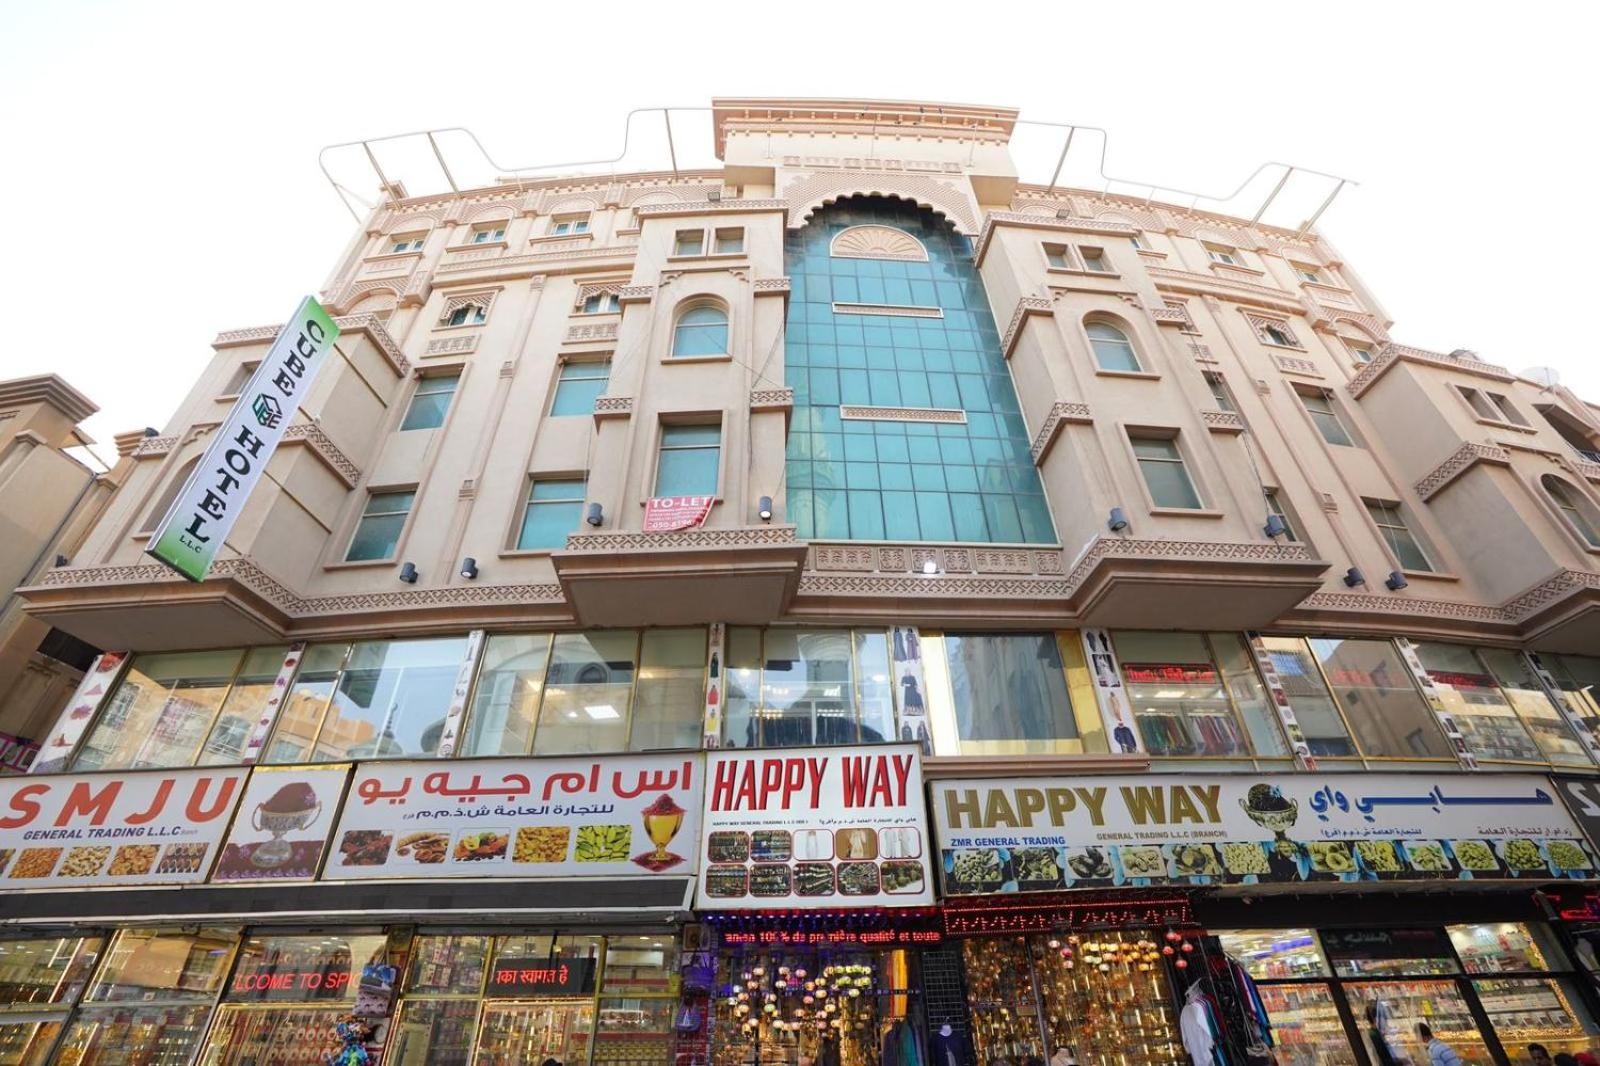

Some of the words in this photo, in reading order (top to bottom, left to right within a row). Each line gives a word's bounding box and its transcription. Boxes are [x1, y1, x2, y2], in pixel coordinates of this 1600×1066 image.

[185, 424, 265, 543] HOTEL
[358, 773, 413, 806] يو
[543, 764, 600, 800] ام
[612, 761, 692, 799] اس
[710, 757, 829, 811] HAPPY
[841, 754, 914, 808] WAY
[0, 777, 239, 829] SMJU
[494, 804, 550, 817] العامة
[553, 804, 614, 817] للتجارة
[944, 785, 1107, 829] HAPPY
[1119, 784, 1222, 826] WAY
[1309, 784, 1350, 822] واي
[23, 828, 82, 840] GENERAL
[87, 827, 145, 839] TRADING
[951, 838, 972, 847] ZMR
[975, 837, 1020, 847] GENERAL
[1022, 836, 1066, 846] TRADING
[1096, 832, 1133, 840] GENERAL
[1135, 831, 1169, 839] TRADING
[1191, 830, 1228, 839] (BRANCH)
[300, 972, 322, 989] TO
